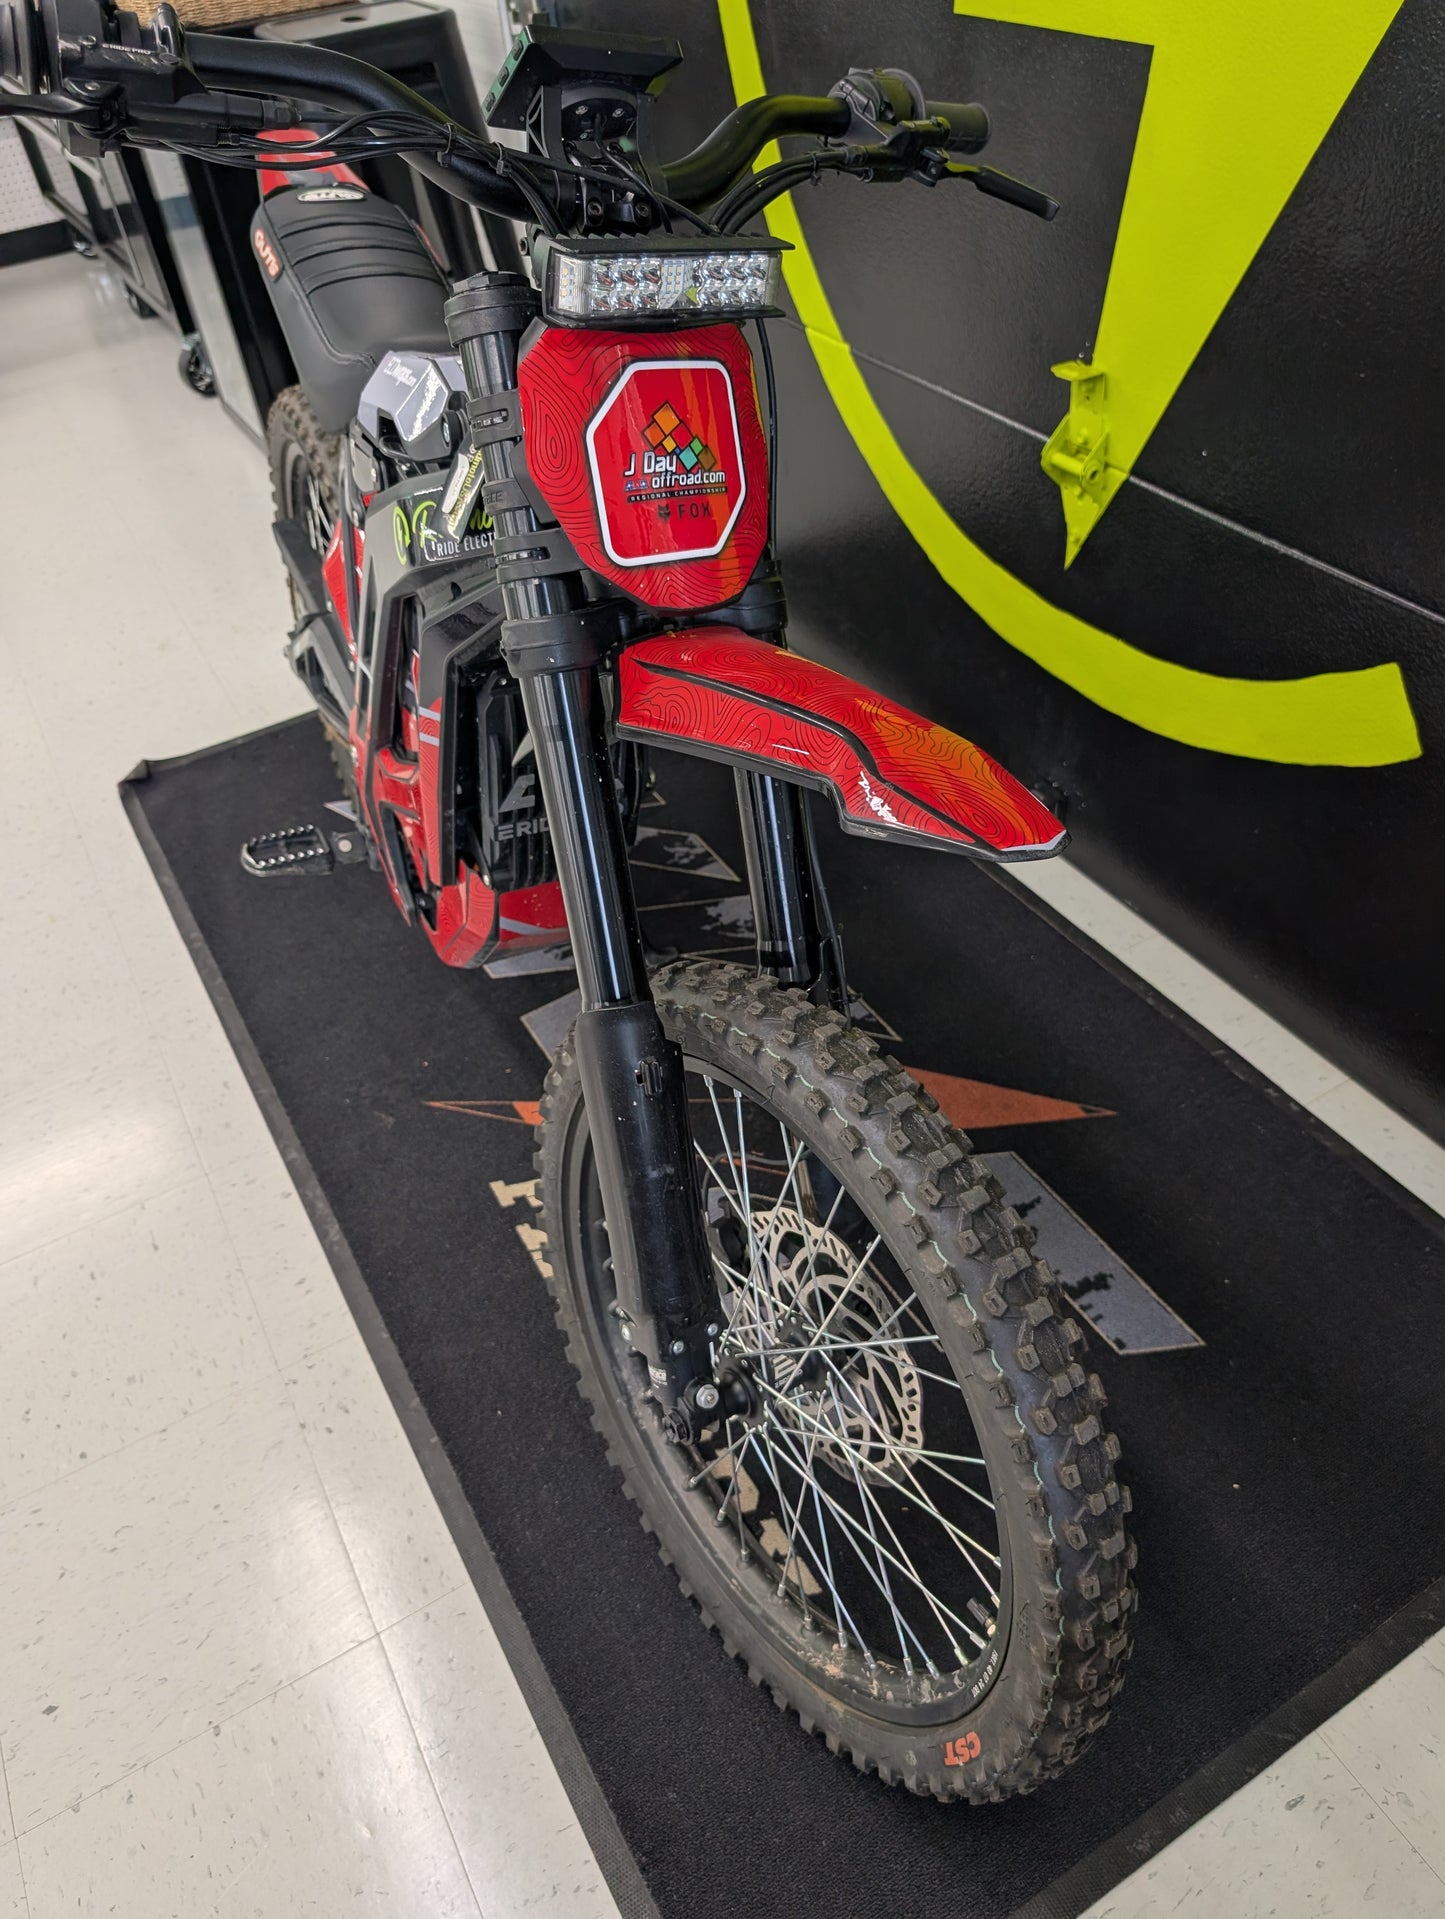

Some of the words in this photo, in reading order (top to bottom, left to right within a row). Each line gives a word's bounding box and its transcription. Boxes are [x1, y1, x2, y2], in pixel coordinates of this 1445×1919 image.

[110, 44, 131, 52] RIDE
[254, 229, 280, 277] GUTS
[624, 453, 636, 476] J
[643, 451, 677, 474] Day
[651, 469, 726, 489] offroad.com
[630, 492, 671, 502] REGIONAL
[674, 487, 726, 497] CHAMPIONSHIP
[678, 503, 711, 519] FOX
[436, 541, 460, 557] RIDE
[944, 1731, 982, 1766] CST
